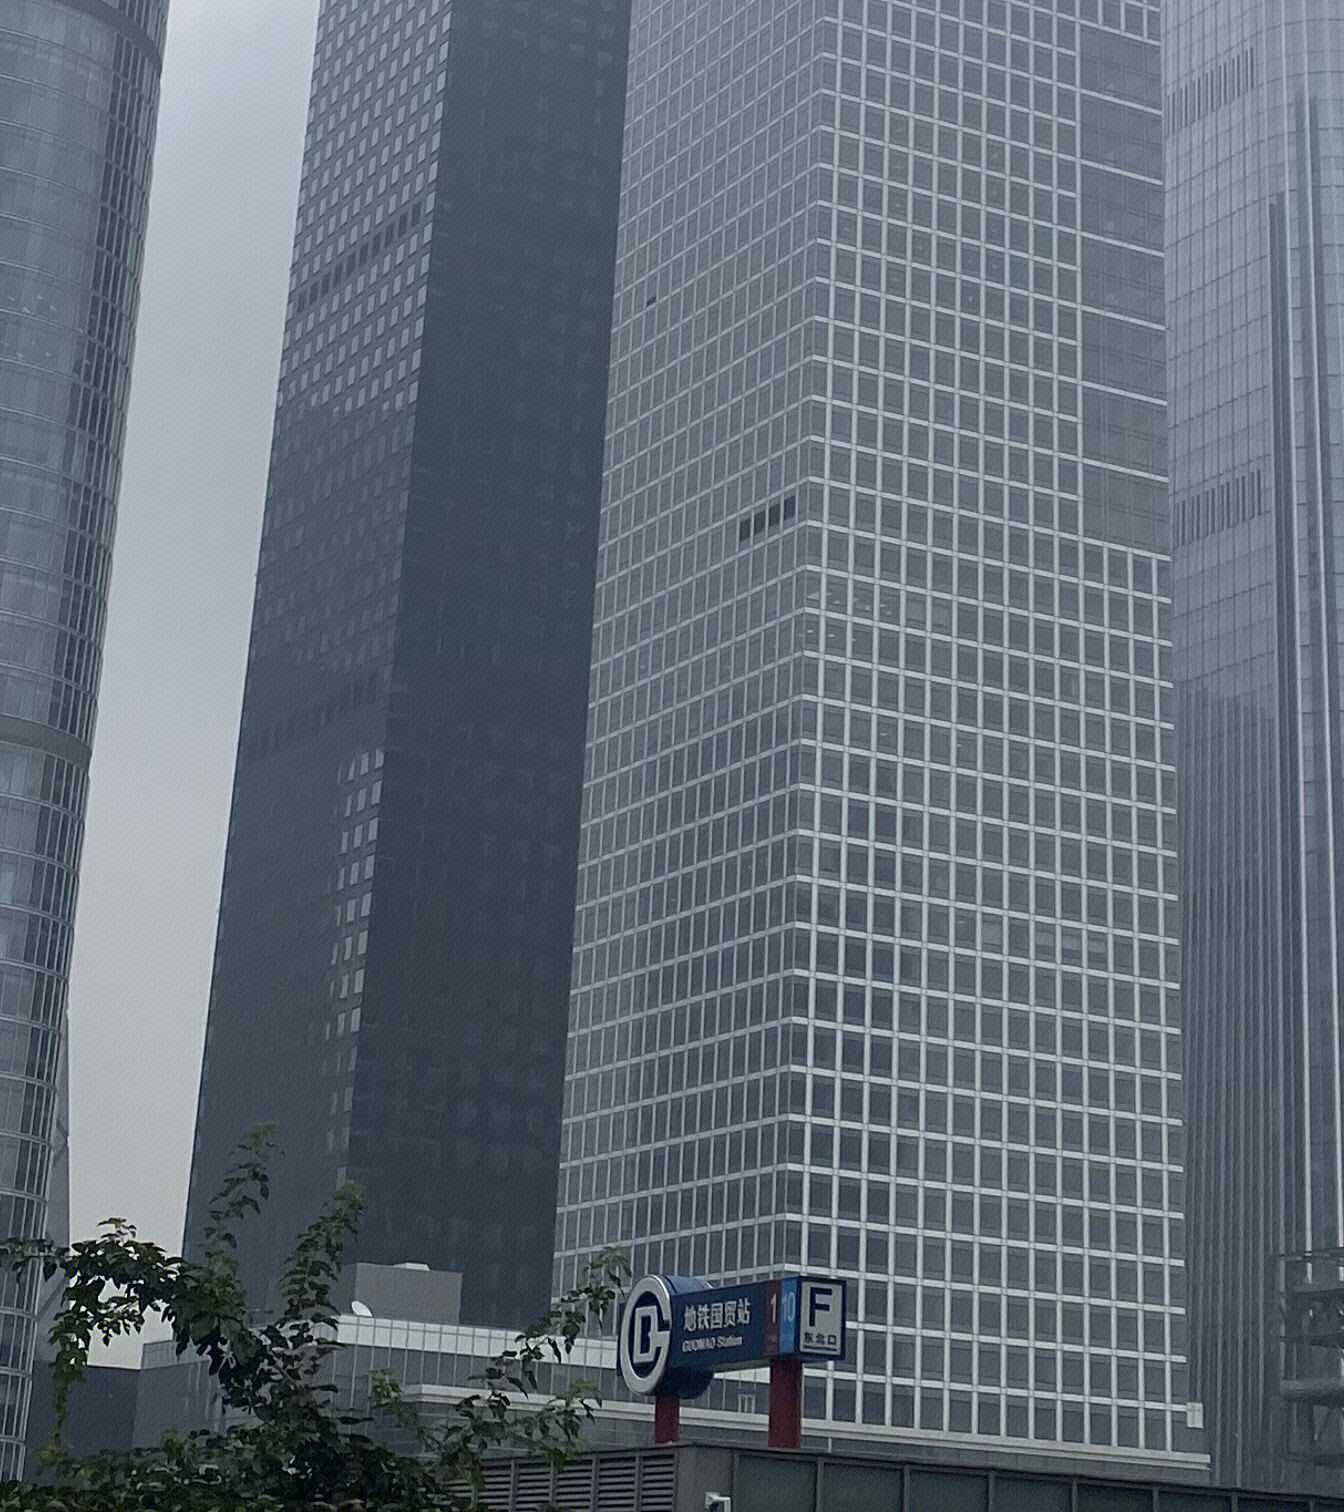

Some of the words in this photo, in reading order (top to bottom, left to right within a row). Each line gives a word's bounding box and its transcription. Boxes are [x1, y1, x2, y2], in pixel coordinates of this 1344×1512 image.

[683, 1298, 752, 1332] 地铁国贸站
[770, 1293, 778, 1324] 1
[782, 1292, 796, 1323] 10
[809, 1286, 833, 1327] F
[681, 1336, 716, 1353] GUOMAO
[717, 1335, 743, 1349] Station
[804, 1331, 838, 1346] 东北口
